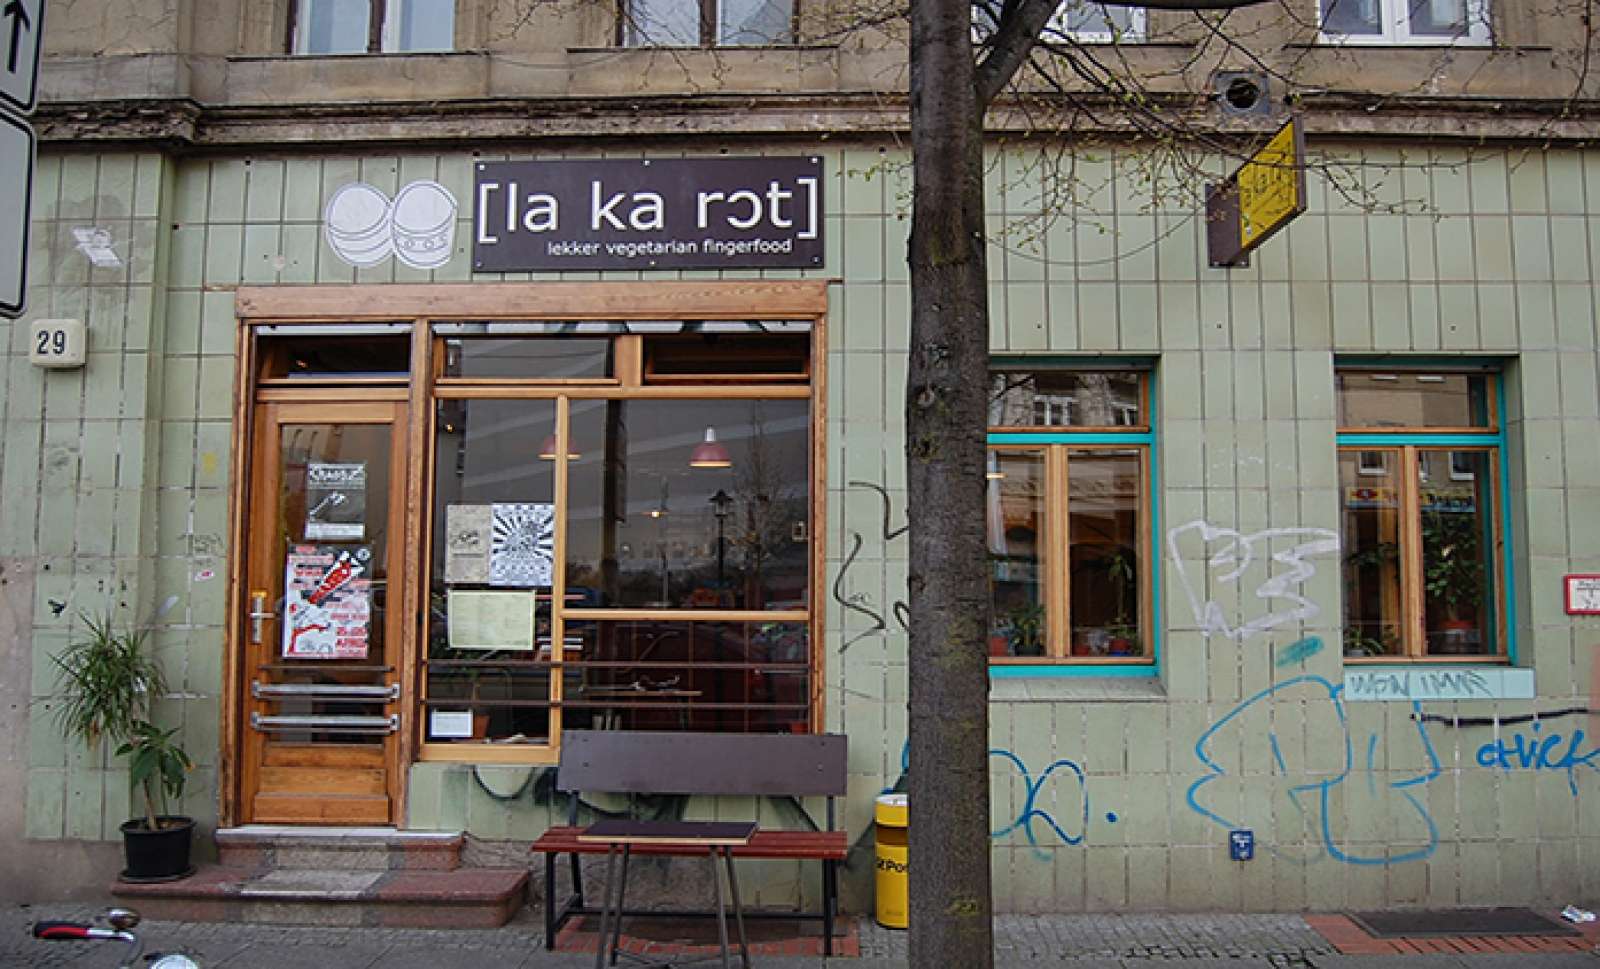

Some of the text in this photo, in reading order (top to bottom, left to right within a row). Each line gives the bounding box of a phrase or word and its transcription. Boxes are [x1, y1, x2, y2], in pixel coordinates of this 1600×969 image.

[591, 181, 664, 231] ka
[548, 238, 793, 258] lekker vegetarian fingerfood
[37, 330, 65, 355] 29
